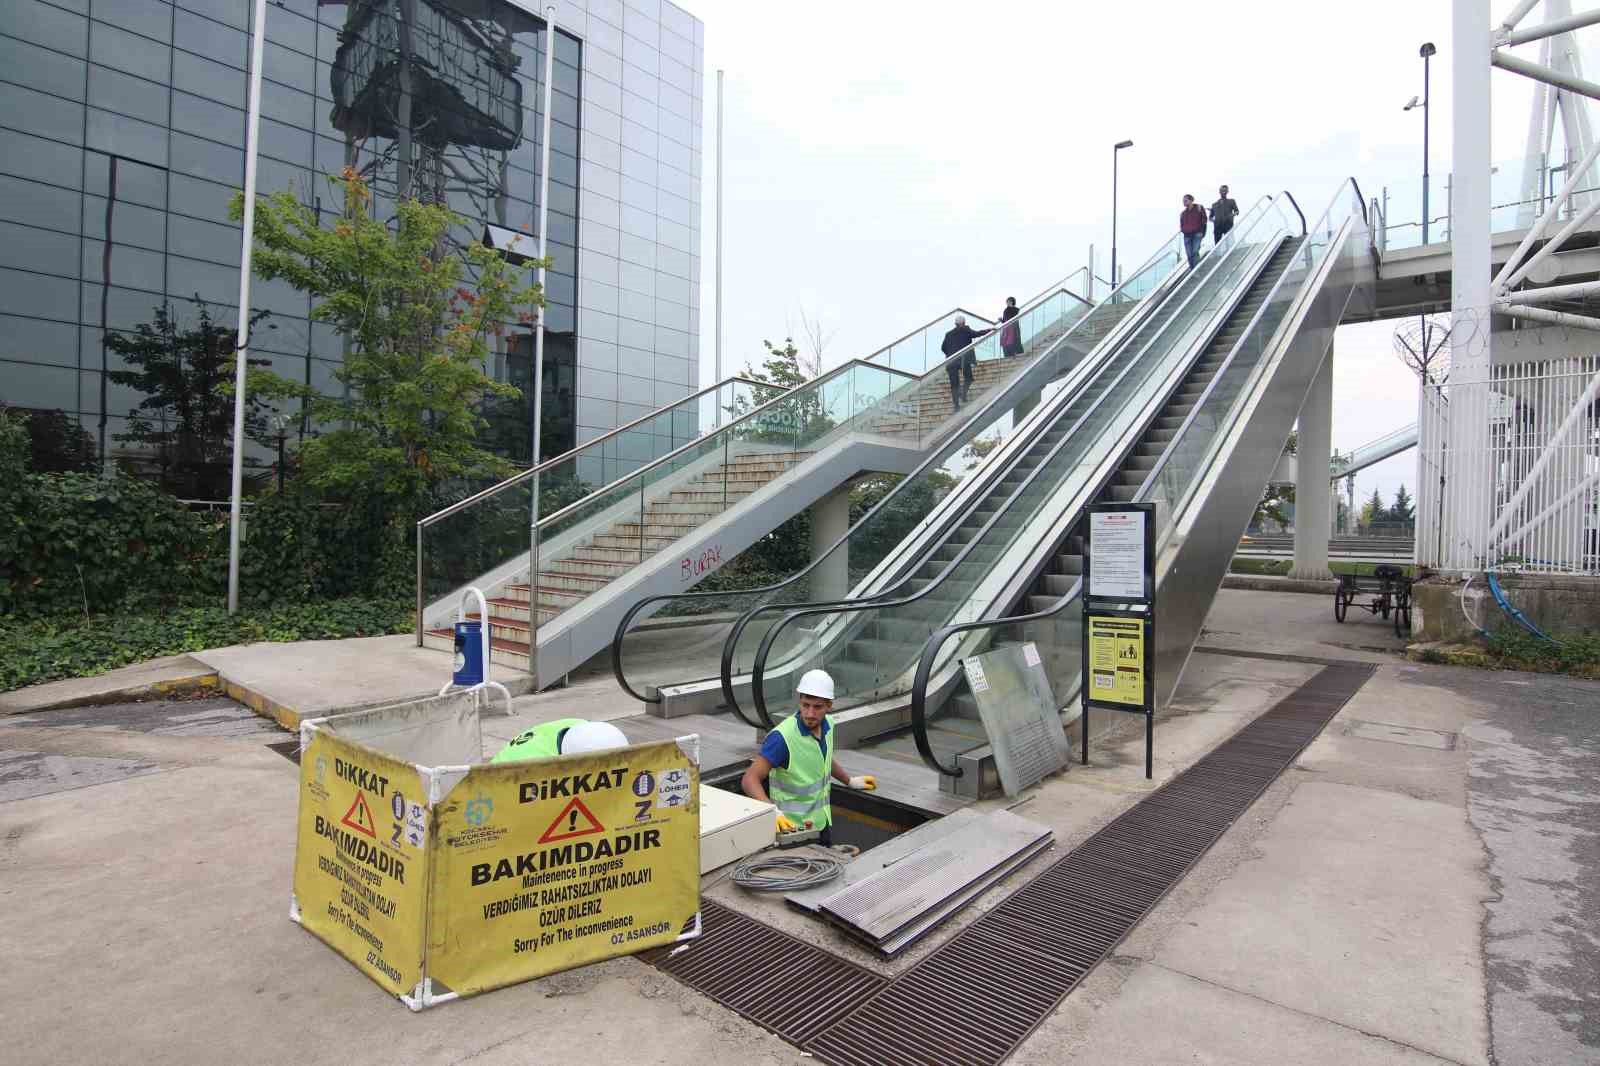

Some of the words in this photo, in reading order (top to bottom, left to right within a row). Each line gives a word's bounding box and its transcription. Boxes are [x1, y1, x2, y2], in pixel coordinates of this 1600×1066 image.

[315, 815, 405, 884] BAKIMDADIR
[471, 829, 661, 886] BAKIMDADIR
[522, 865, 577, 889] Maintenence
[578, 863, 588, 877] in
[589, 858, 623, 879] progress
[541, 878, 619, 906] RAHATSIZLIKTAN
[621, 868, 652, 887] DOLAYI
[514, 935, 538, 953] Sorry
[540, 931, 554, 946] For
[556, 928, 573, 943] The
[575, 915, 634, 938] inconvenience
